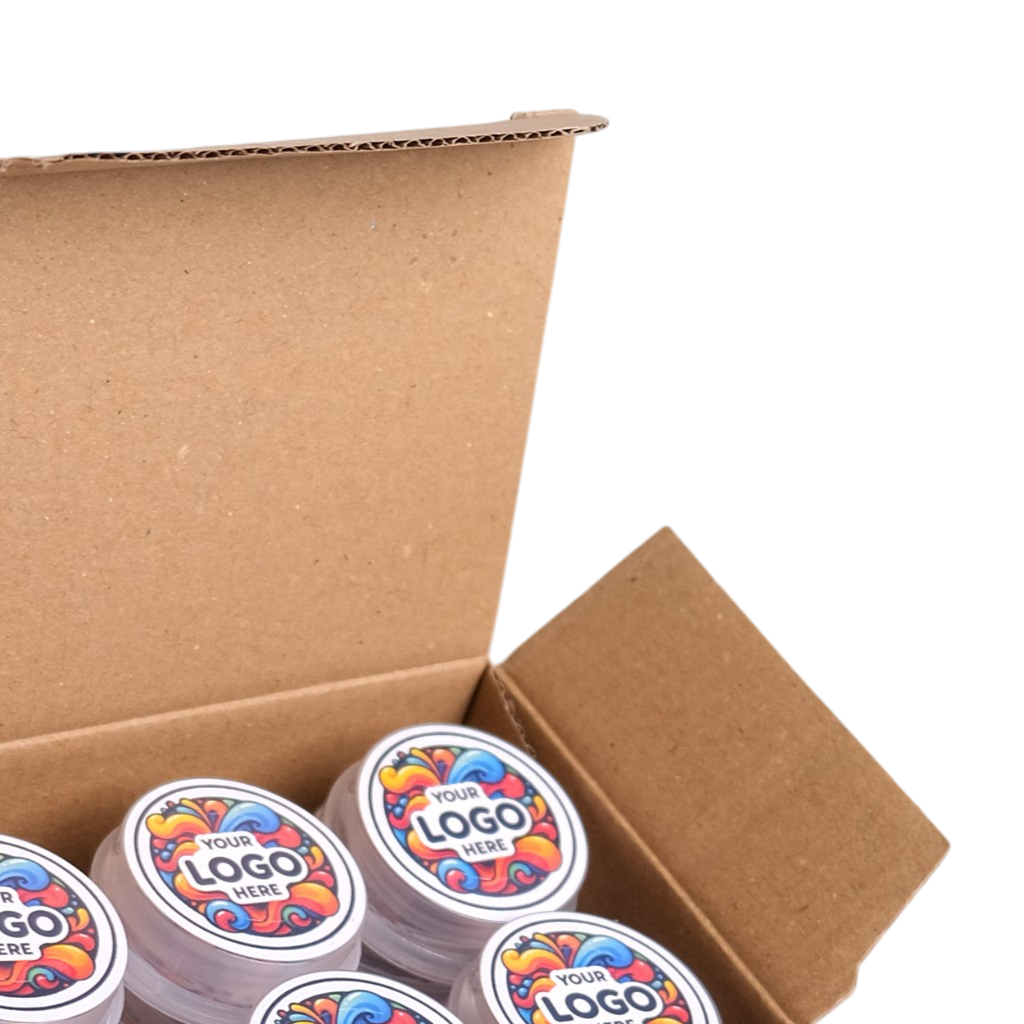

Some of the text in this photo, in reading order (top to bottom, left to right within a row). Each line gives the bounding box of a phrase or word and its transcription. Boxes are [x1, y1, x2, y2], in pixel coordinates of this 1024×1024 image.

[432, 787, 478, 803] YOUR
[416, 802, 526, 844] LOGO
[201, 835, 252, 850] YOUR
[462, 838, 507, 856] HERE
[184, 850, 302, 886] LOGO
[232, 883, 282, 899] HERE
[556, 970, 607, 986] YOUR
[541, 985, 658, 1023] LOGO
